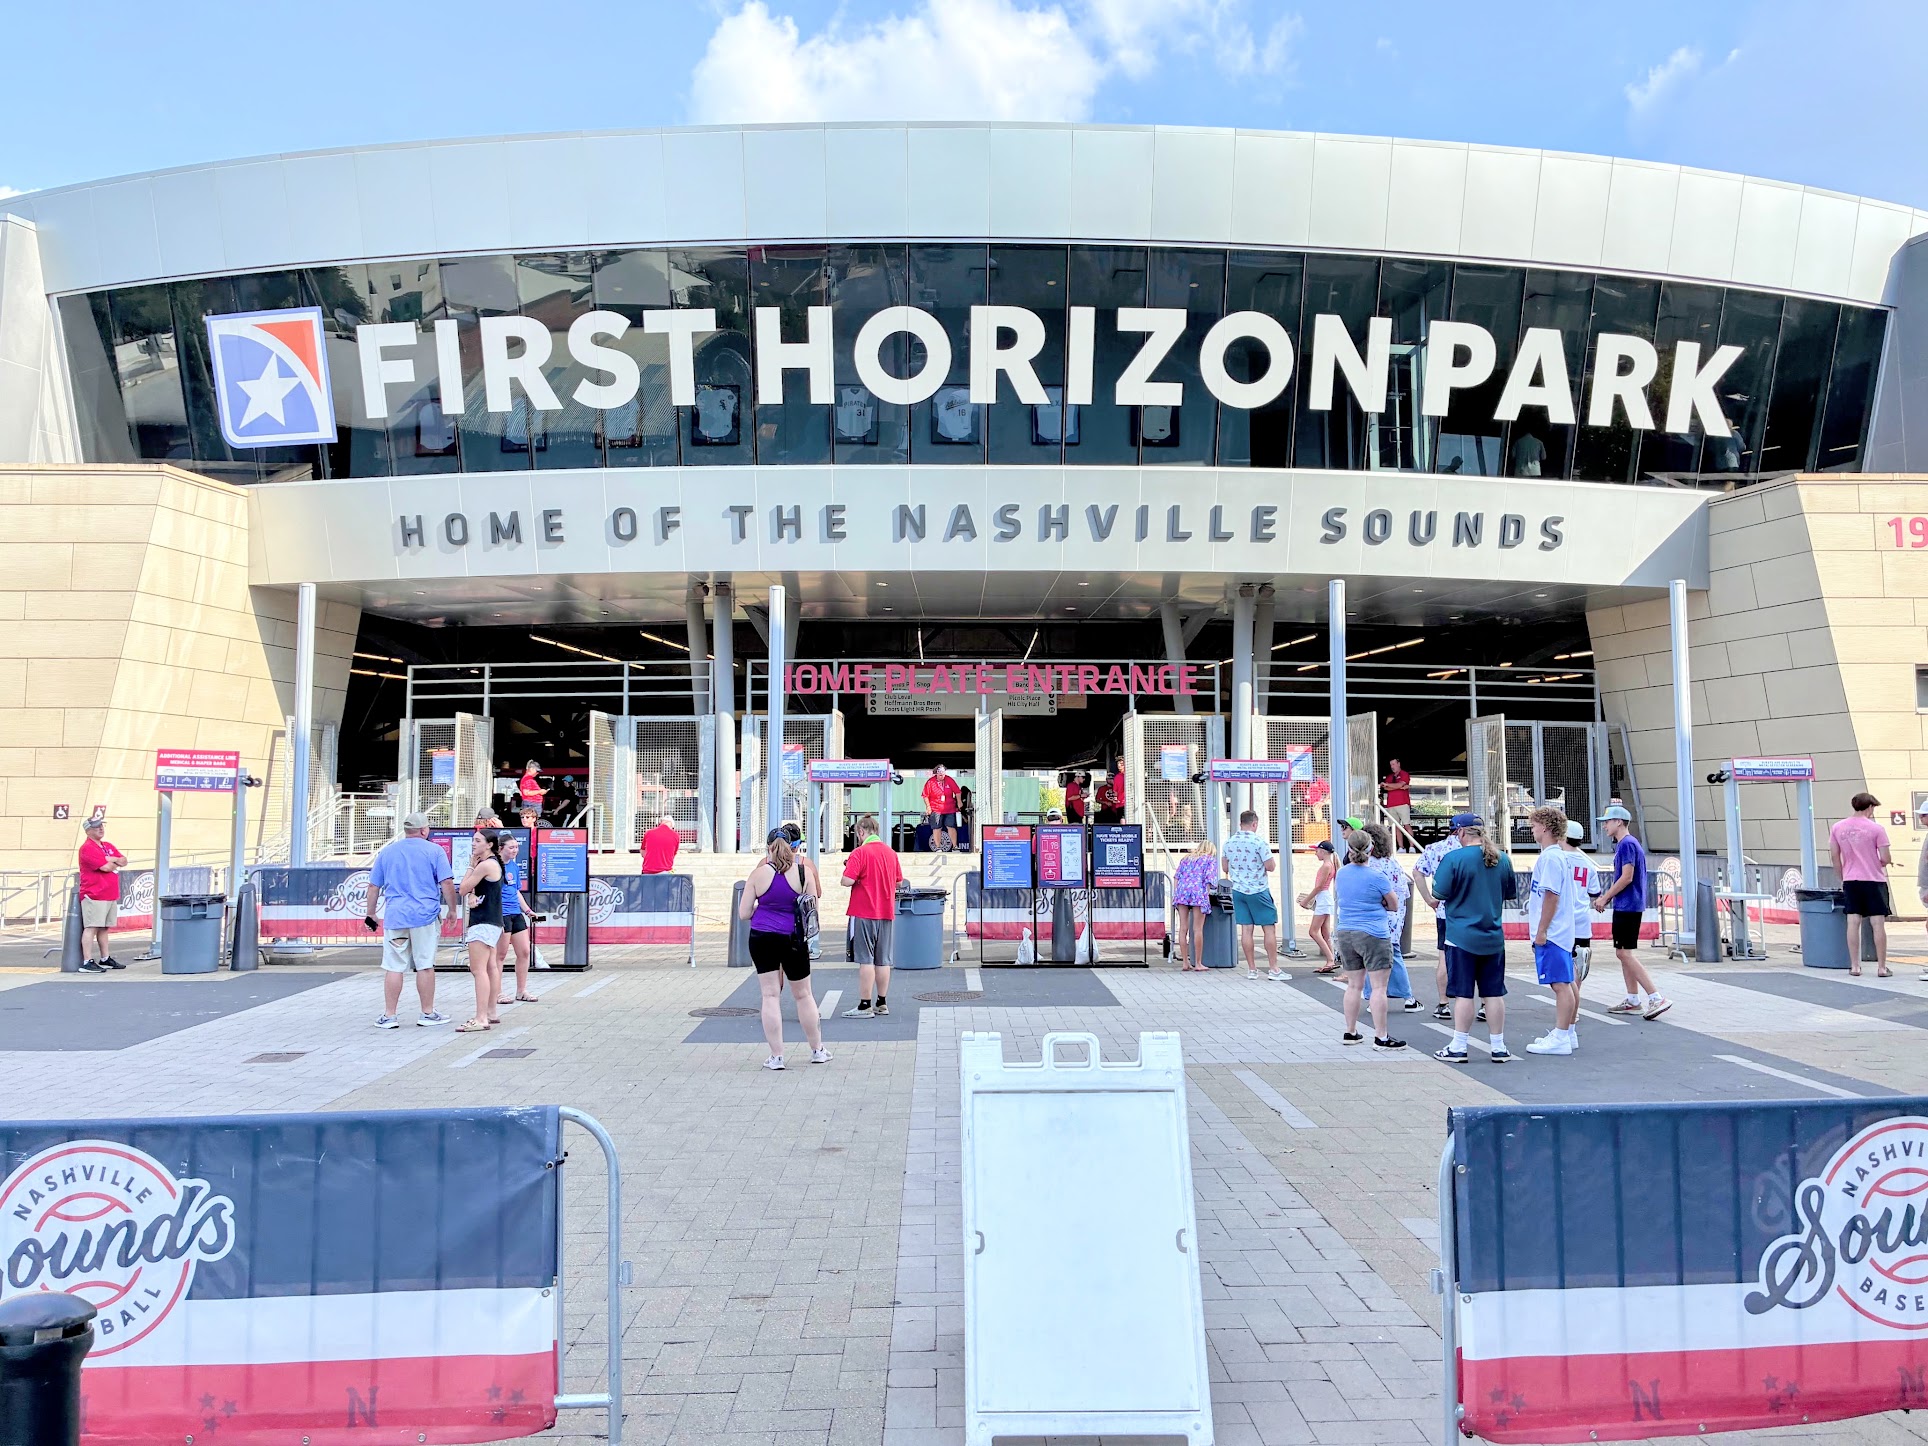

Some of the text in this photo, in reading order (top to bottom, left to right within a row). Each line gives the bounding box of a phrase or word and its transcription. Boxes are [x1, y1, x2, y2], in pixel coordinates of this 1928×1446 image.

[356, 305, 1744, 438] FIRST HORIZON PARK
[400, 503, 1565, 551] HOME OF THE NASHVILLE SOUNDS
[1887, 516, 1928, 548] 19
[885, 664, 995, 695] PLATE
[1005, 664, 1199, 695] ENTRANCE
[1573, 866, 1588, 888] 4
[1841, 1140, 1925, 1198] NASHVI
[13, 1164, 153, 1222] NASHVILLE
[1858, 1276, 1926, 1312] BASE
